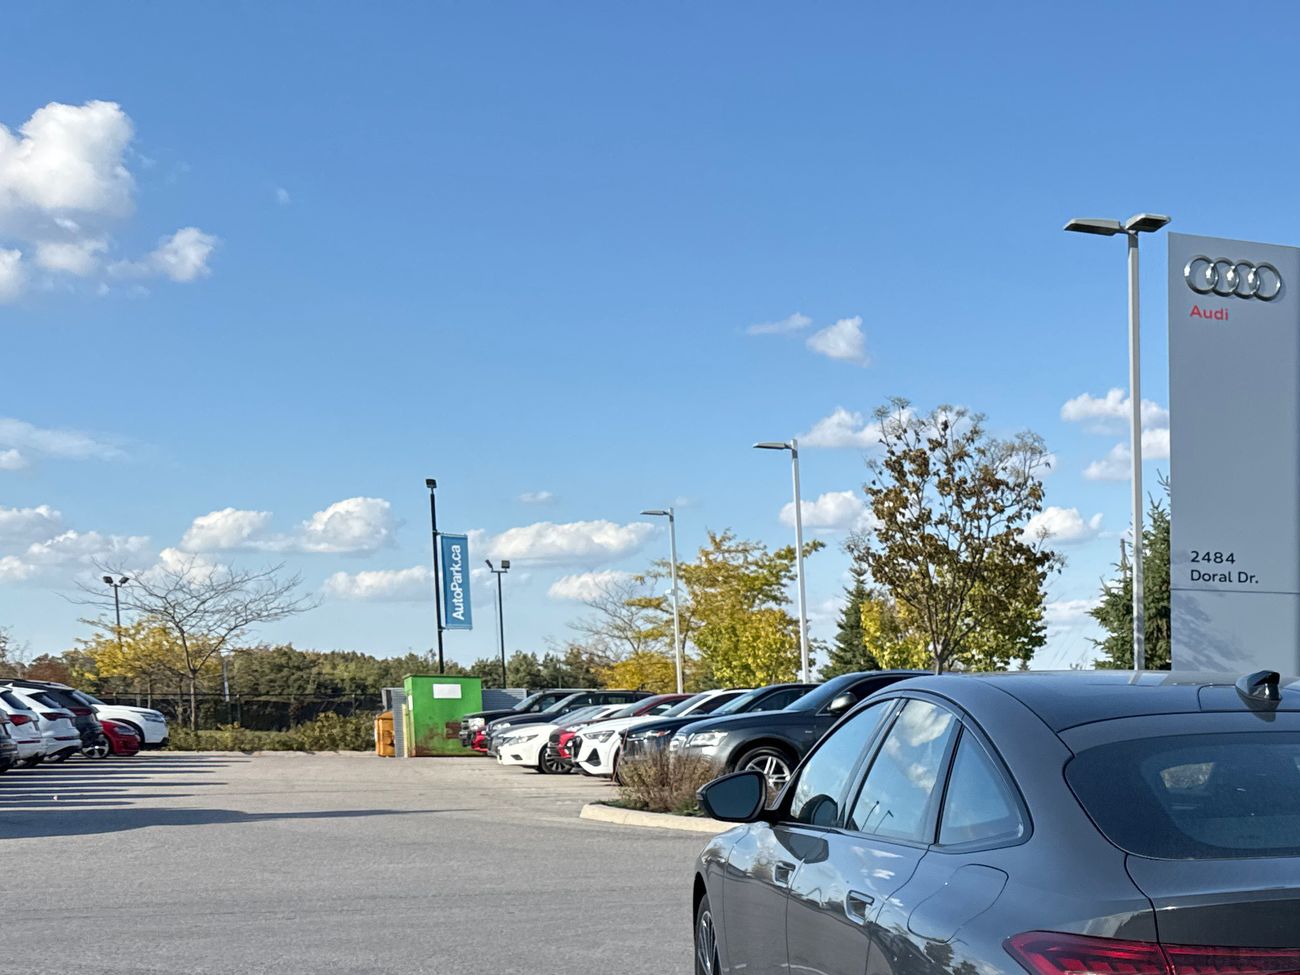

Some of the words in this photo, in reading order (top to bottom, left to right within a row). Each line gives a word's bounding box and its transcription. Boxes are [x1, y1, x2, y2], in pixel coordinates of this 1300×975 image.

[1189, 304, 1229, 321] Audi
[1190, 550, 1236, 565] 2484
[450, 544, 465, 621] AutoPark.ca
[1190, 569, 1233, 583] Doral
[1238, 571, 1259, 584] Dr.
